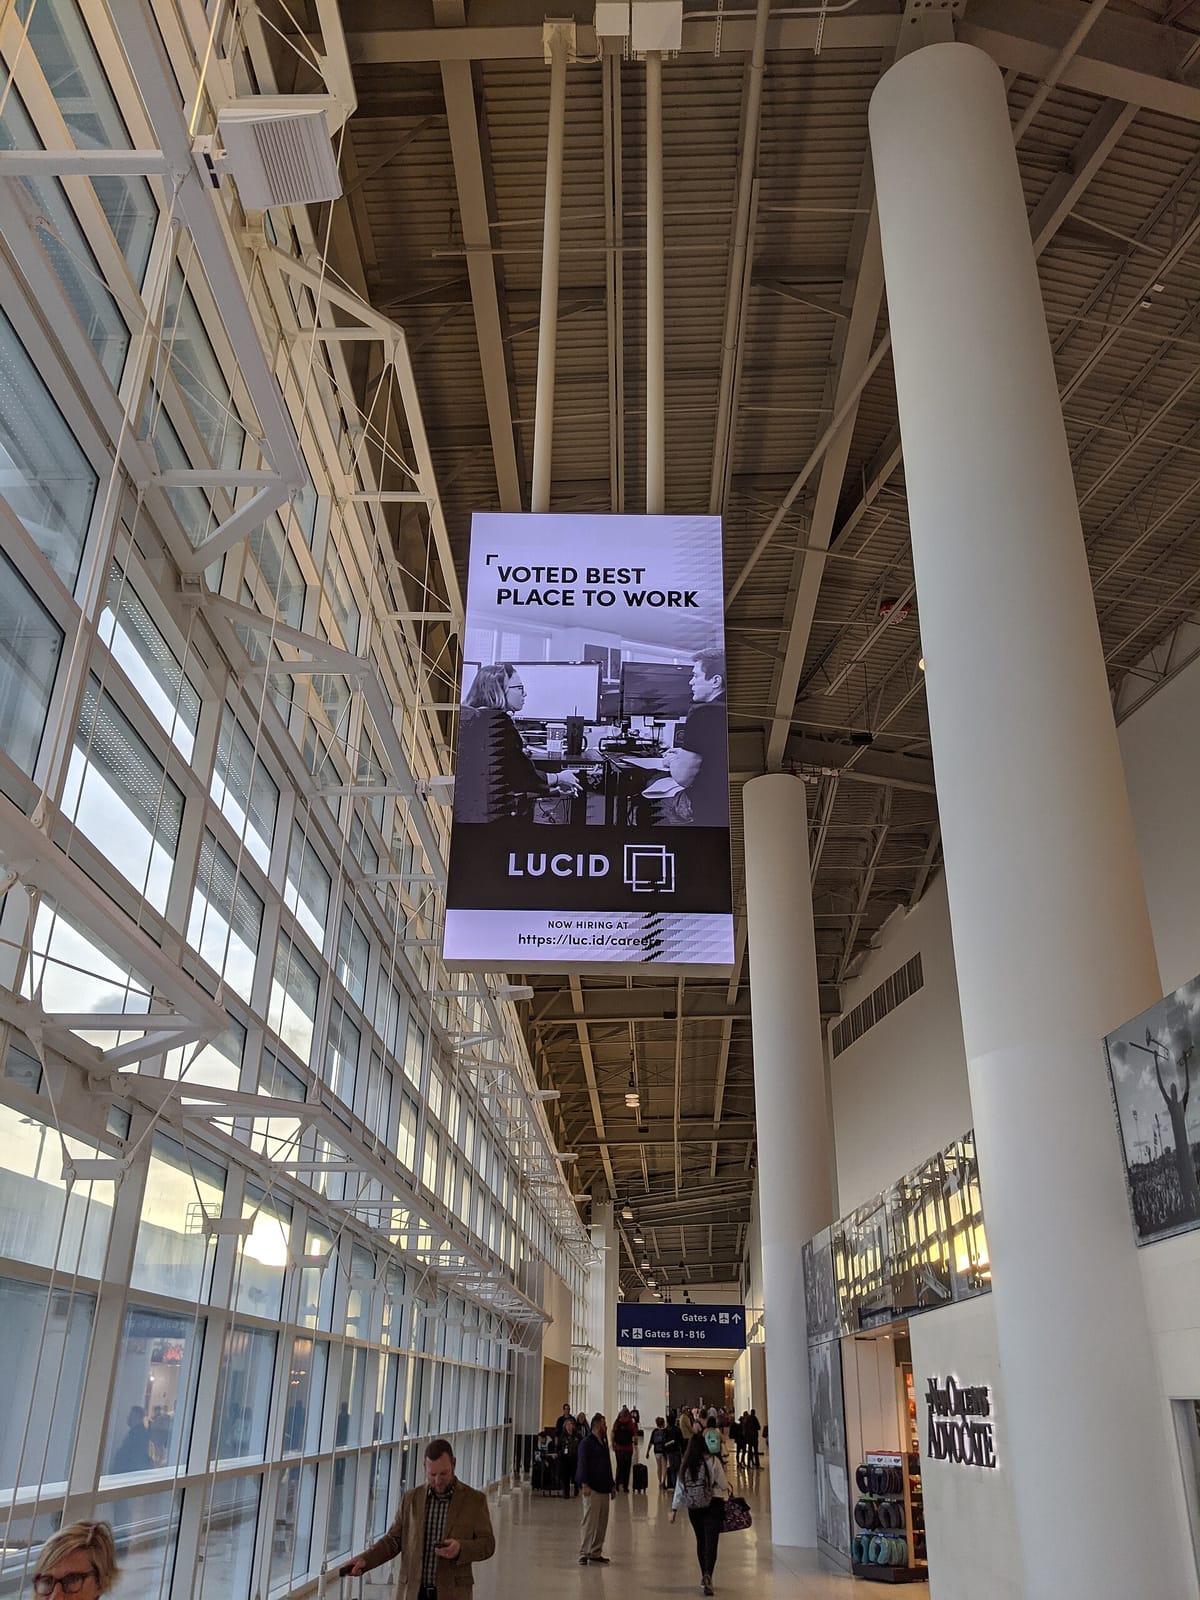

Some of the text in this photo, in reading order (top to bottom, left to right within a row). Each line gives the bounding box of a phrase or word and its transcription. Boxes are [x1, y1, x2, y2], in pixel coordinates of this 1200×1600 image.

[497, 566, 646, 584] VOTED BEST
[497, 588, 700, 608] PLACE TO WORK
[508, 852, 610, 877] LUCID
[547, 920, 629, 930] NOW HIRING AT
[681, 1313, 718, 1323] Gates A
[644, 1329, 706, 1340] Gates B1-B16
